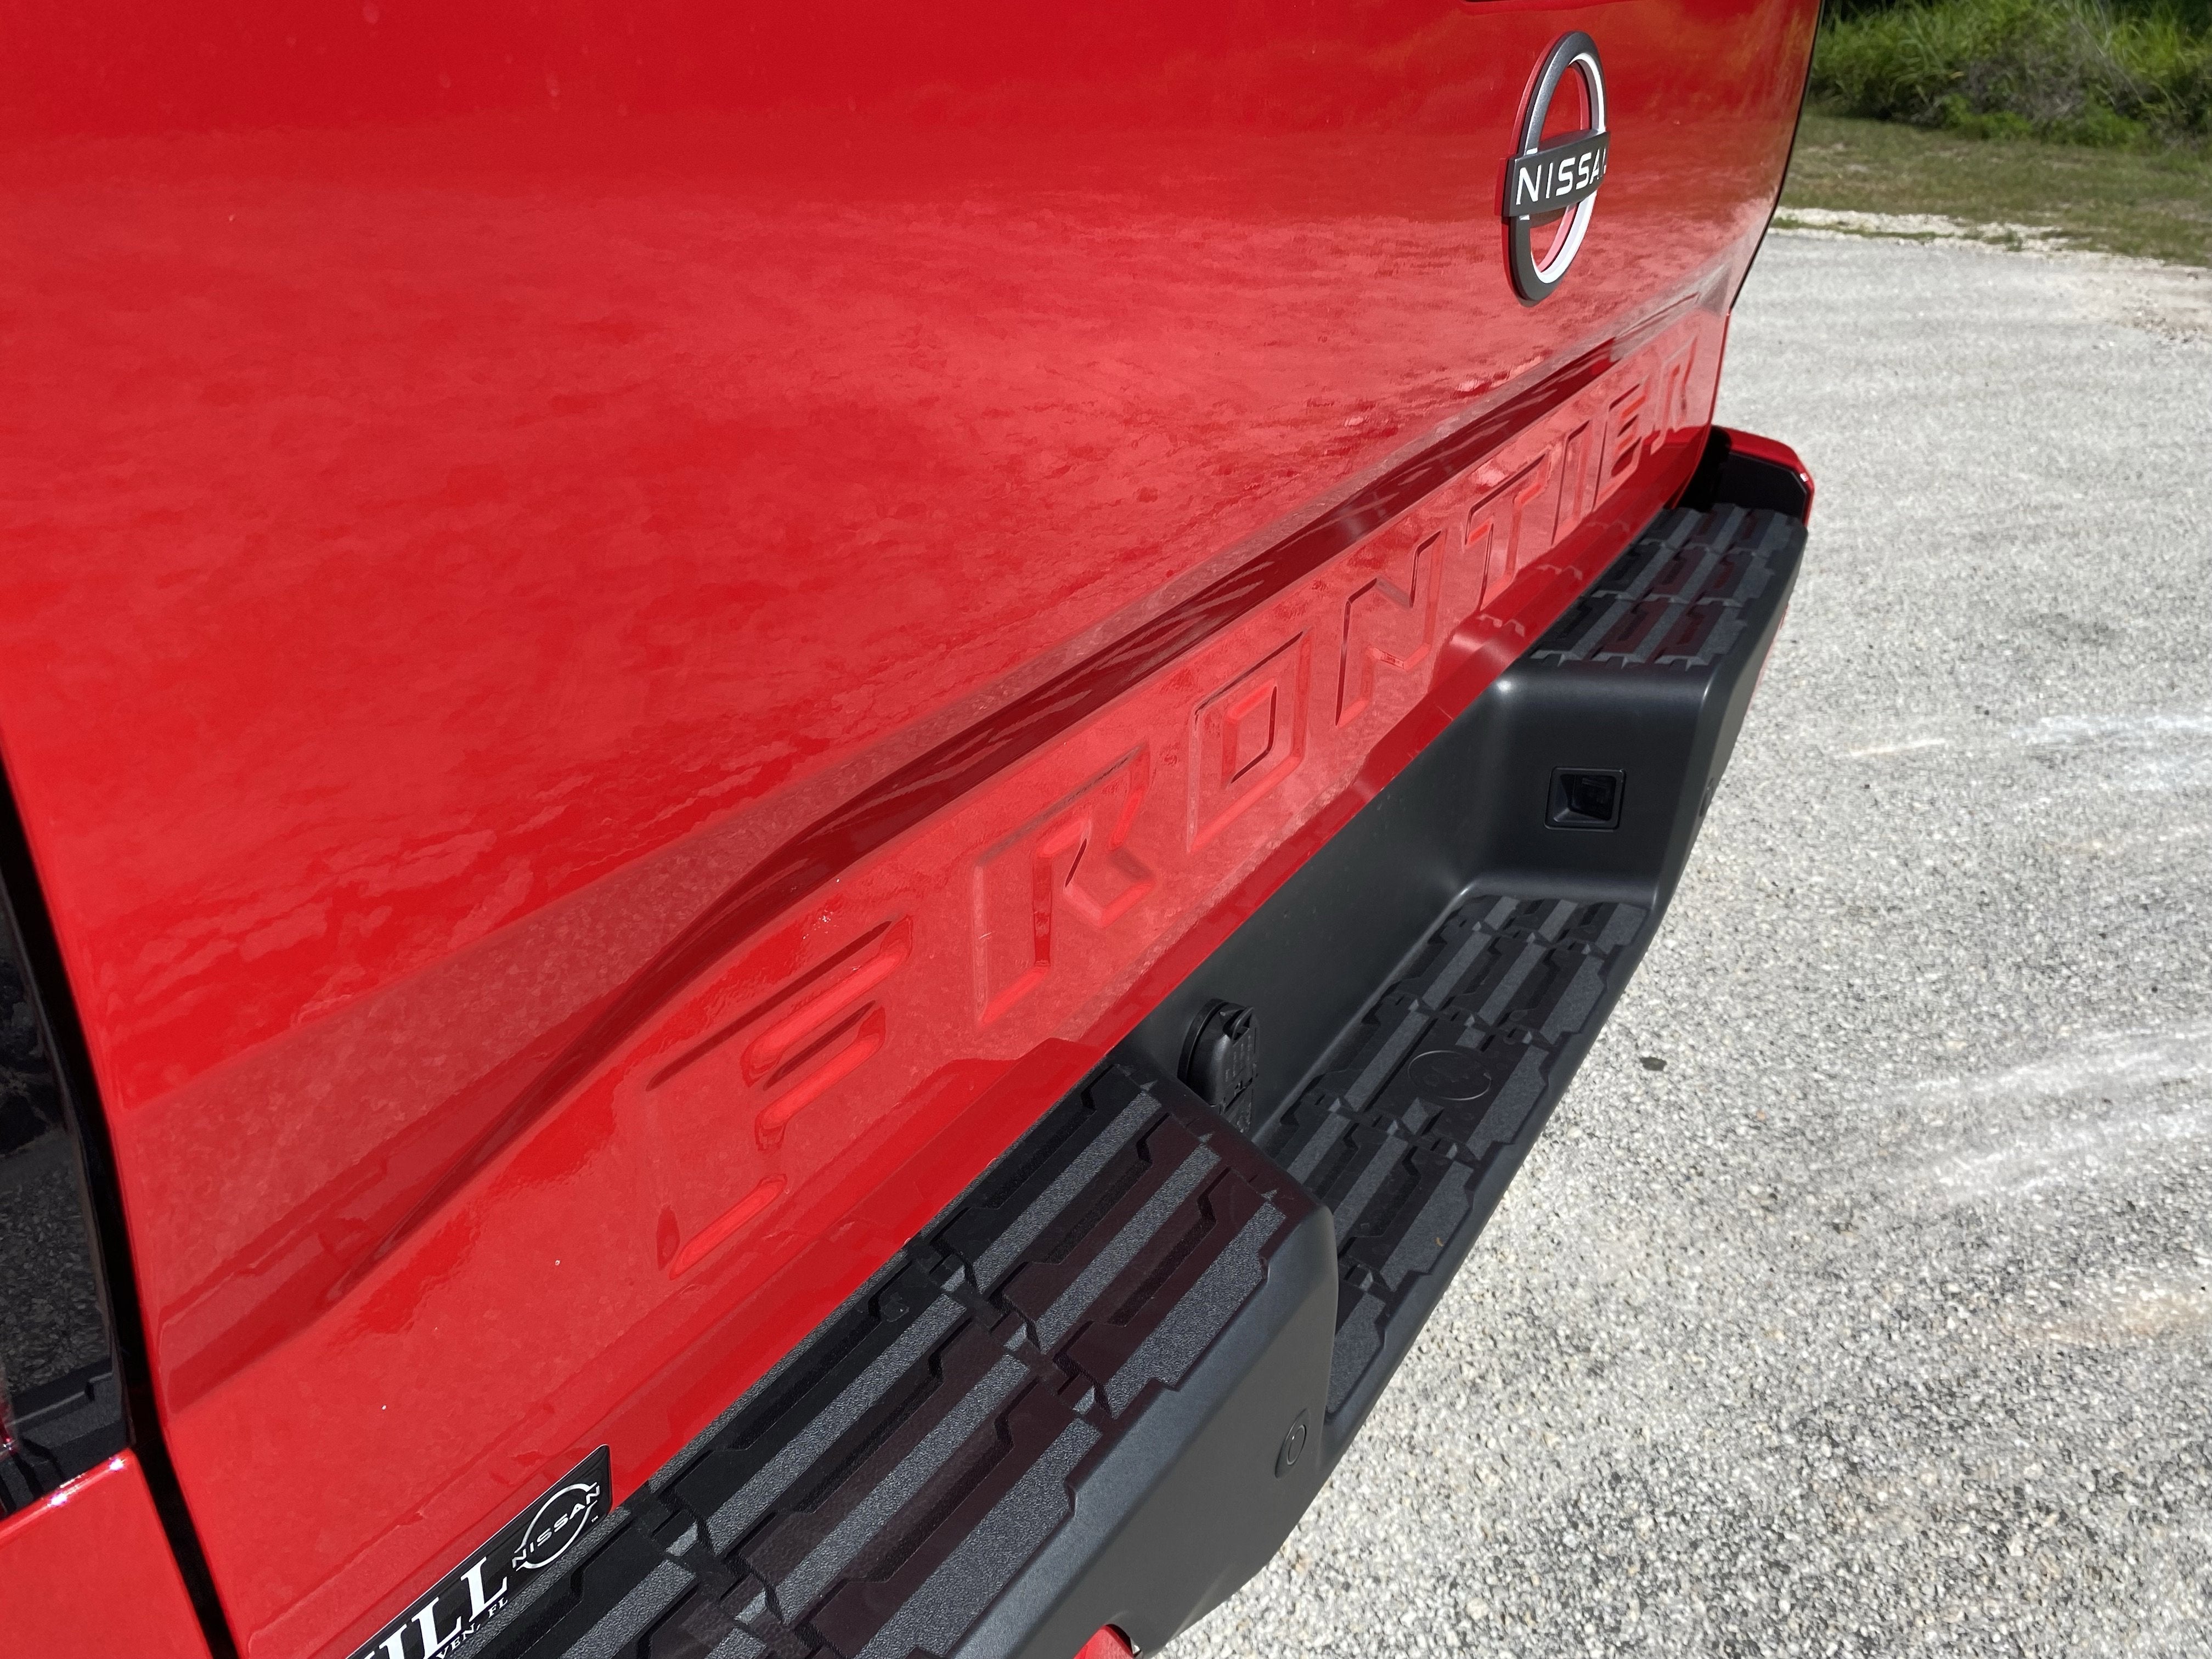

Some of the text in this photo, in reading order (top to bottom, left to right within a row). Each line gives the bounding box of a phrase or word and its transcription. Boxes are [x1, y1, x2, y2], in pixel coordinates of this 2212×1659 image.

[512, 1485, 600, 1568] NISSAN
[363, 1556, 507, 1659] ILL
[488, 1597, 508, 1618] FL
